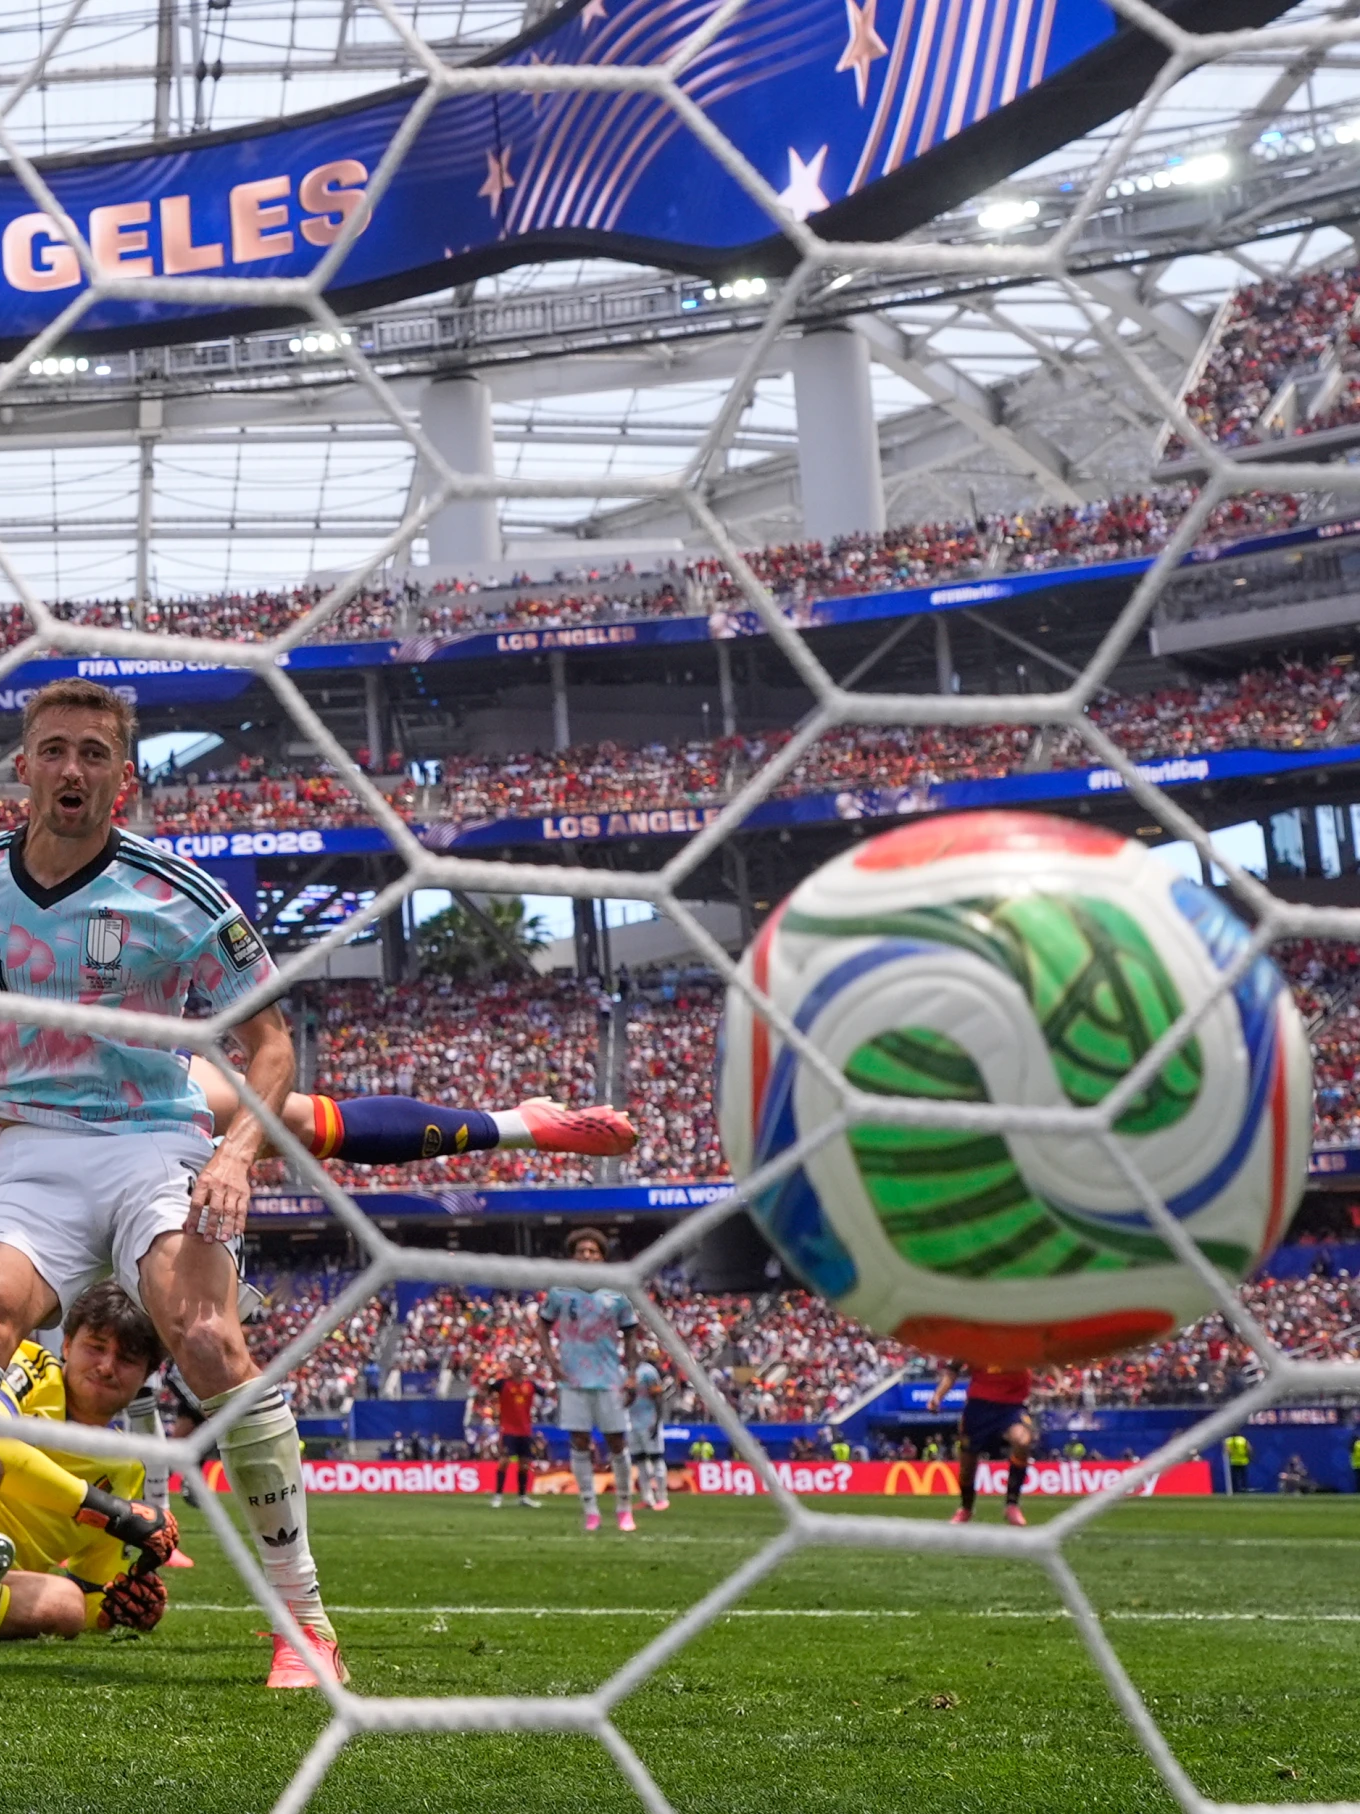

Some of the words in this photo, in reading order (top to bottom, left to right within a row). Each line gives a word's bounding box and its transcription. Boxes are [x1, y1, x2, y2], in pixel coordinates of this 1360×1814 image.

[497, 633, 538, 651] LOS
[542, 626, 636, 648] ANGELES
[78, 660, 118, 677] FIFA
[118, 659, 184, 675] WORLD
[543, 815, 600, 840] LOS
[607, 808, 722, 837] ANGELE
[175, 835, 228, 857] CUP
[230, 831, 323, 855] 2026
[250, 1197, 324, 1214] NGELES
[648, 1188, 689, 1206] FIFA
[699, 1461, 756, 1496] Big
[974, 1460, 1160, 1497] McDelivey
[248, 1484, 297, 1506] RBFA
